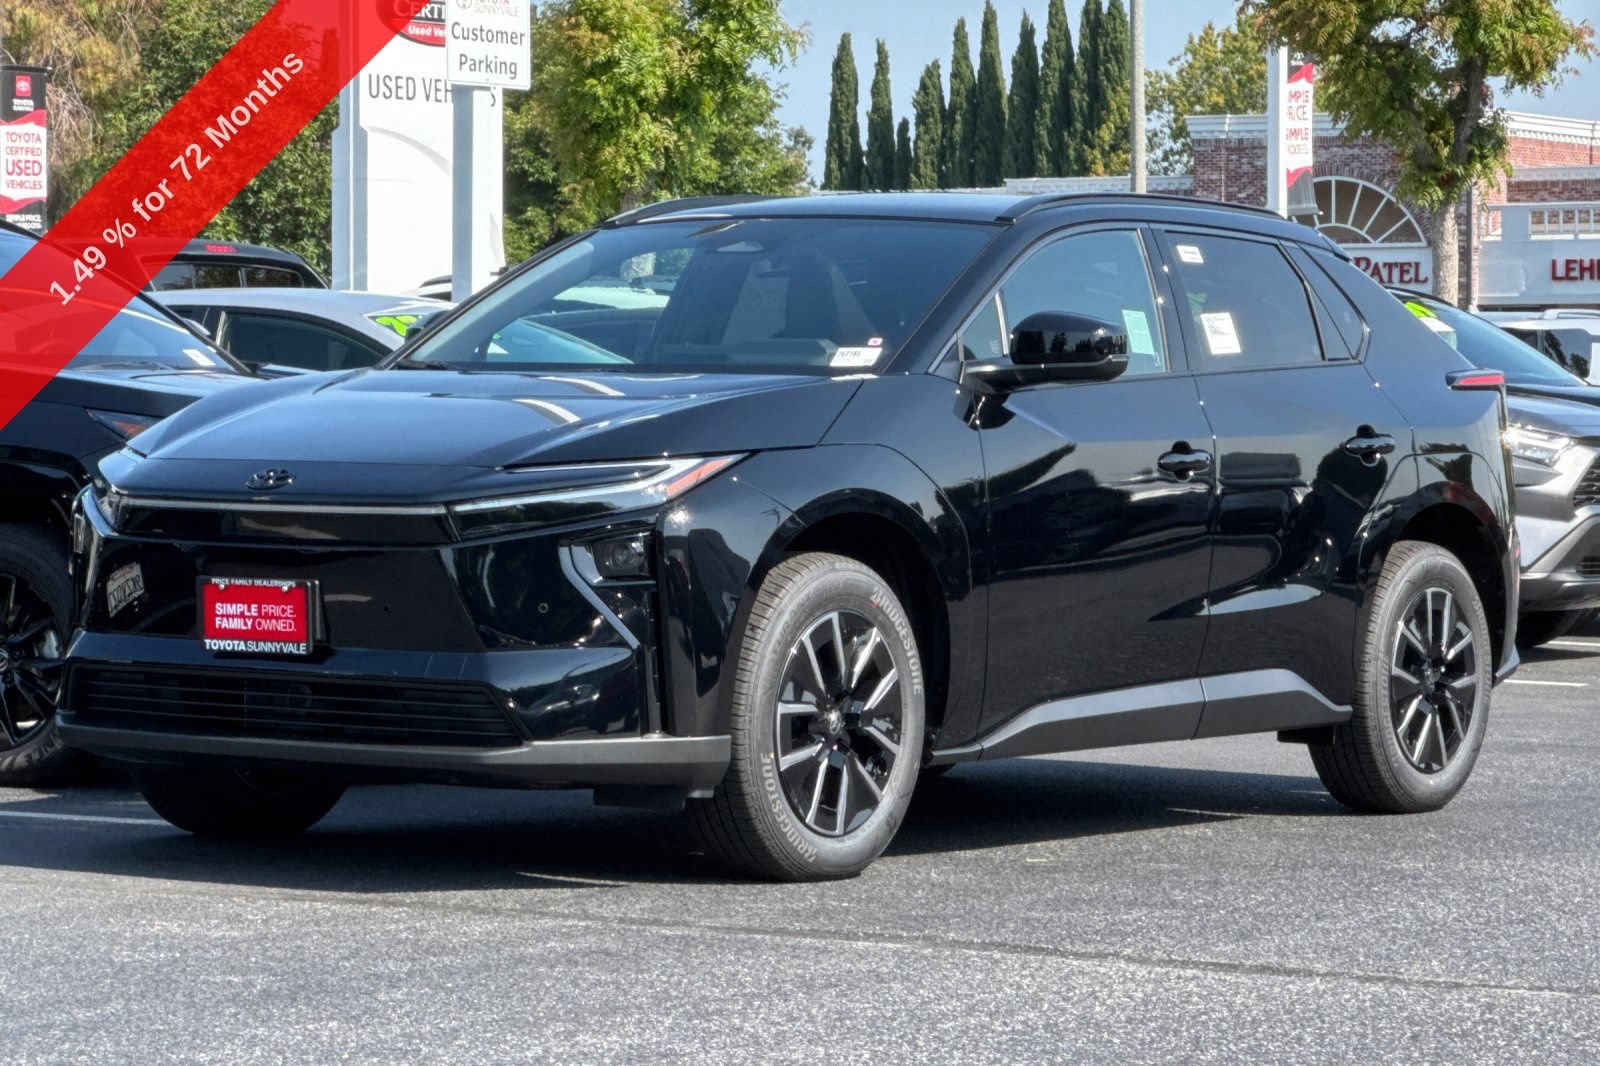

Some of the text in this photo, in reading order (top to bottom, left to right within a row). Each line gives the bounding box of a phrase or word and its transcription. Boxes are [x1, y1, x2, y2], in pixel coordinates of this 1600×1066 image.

[473, 2, 520, 17] SUNNYVALE
[408, 24, 432, 37] Used
[451, 22, 526, 46] Customer
[459, 53, 518, 80] Parking
[368, 73, 416, 101] USED
[5, 131, 42, 144] TOYOTA
[5, 146, 43, 157] CERTIFIED
[5, 159, 43, 176] USED
[5, 179, 43, 190] VEHICLES
[1353, 256, 1429, 285] PATEL
[211, 578, 230, 586] PRICE
[254, 580, 296, 588] DEALERSHIPS
[215, 602, 297, 618] SIMPLE PRICE.
[215, 616, 297, 632] FAMILY OWNED.
[870, 585, 922, 696] BRIDGESTONE
[760, 752, 818, 864] BRIDGESTONE
